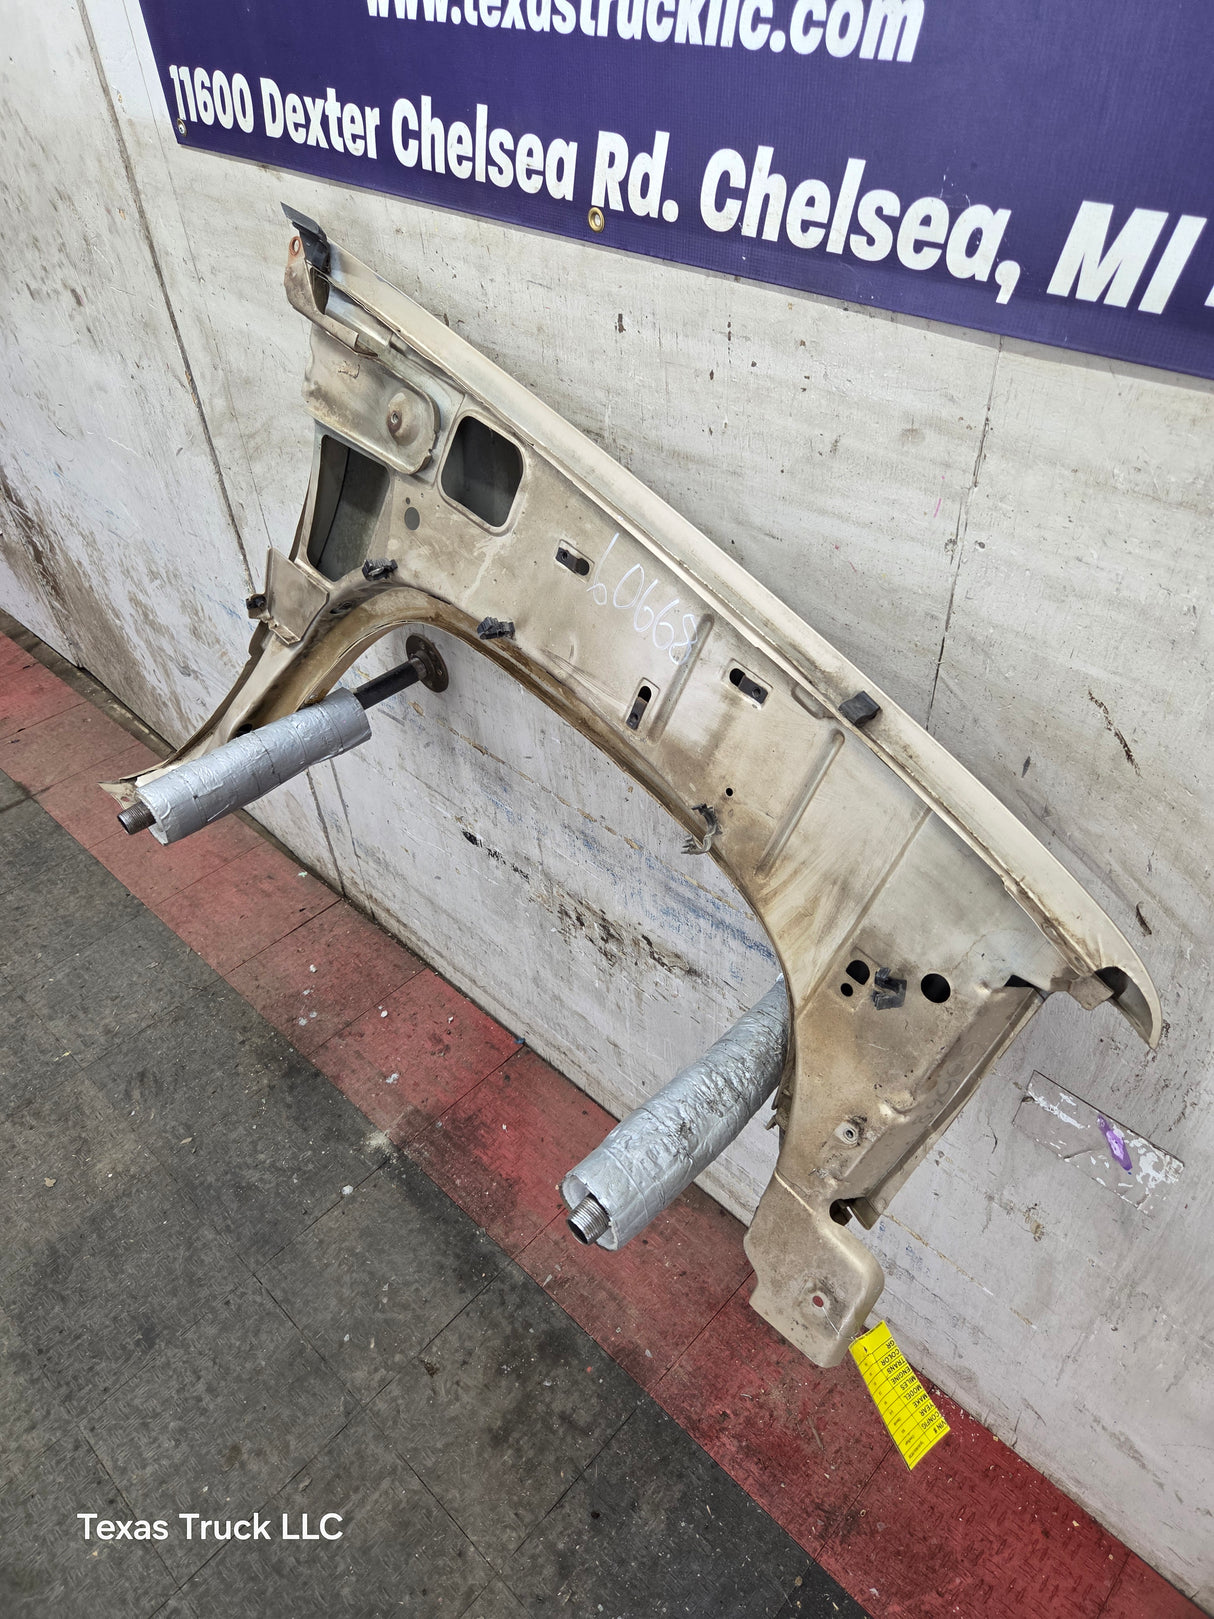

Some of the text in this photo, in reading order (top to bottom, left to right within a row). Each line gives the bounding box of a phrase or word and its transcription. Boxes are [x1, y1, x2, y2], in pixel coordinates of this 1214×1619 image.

[169, 64, 1207, 314] 11600 Dexter Chelsea Rd. Chelsea, MI
[886, 1340, 895, 1349] GR
[881, 1349, 900, 1366] COLOR
[887, 1358, 905, 1374] TRANS
[891, 1366, 911, 1385] ENGINE
[900, 1376, 917, 1391] MILES
[904, 1385, 922, 1400] MODEL
[913, 1394, 928, 1409] MAKE
[919, 1402, 934, 1417] YEAR
[921, 1411, 940, 1430] CONFIG
[937, 1421, 947, 1430] VIN
